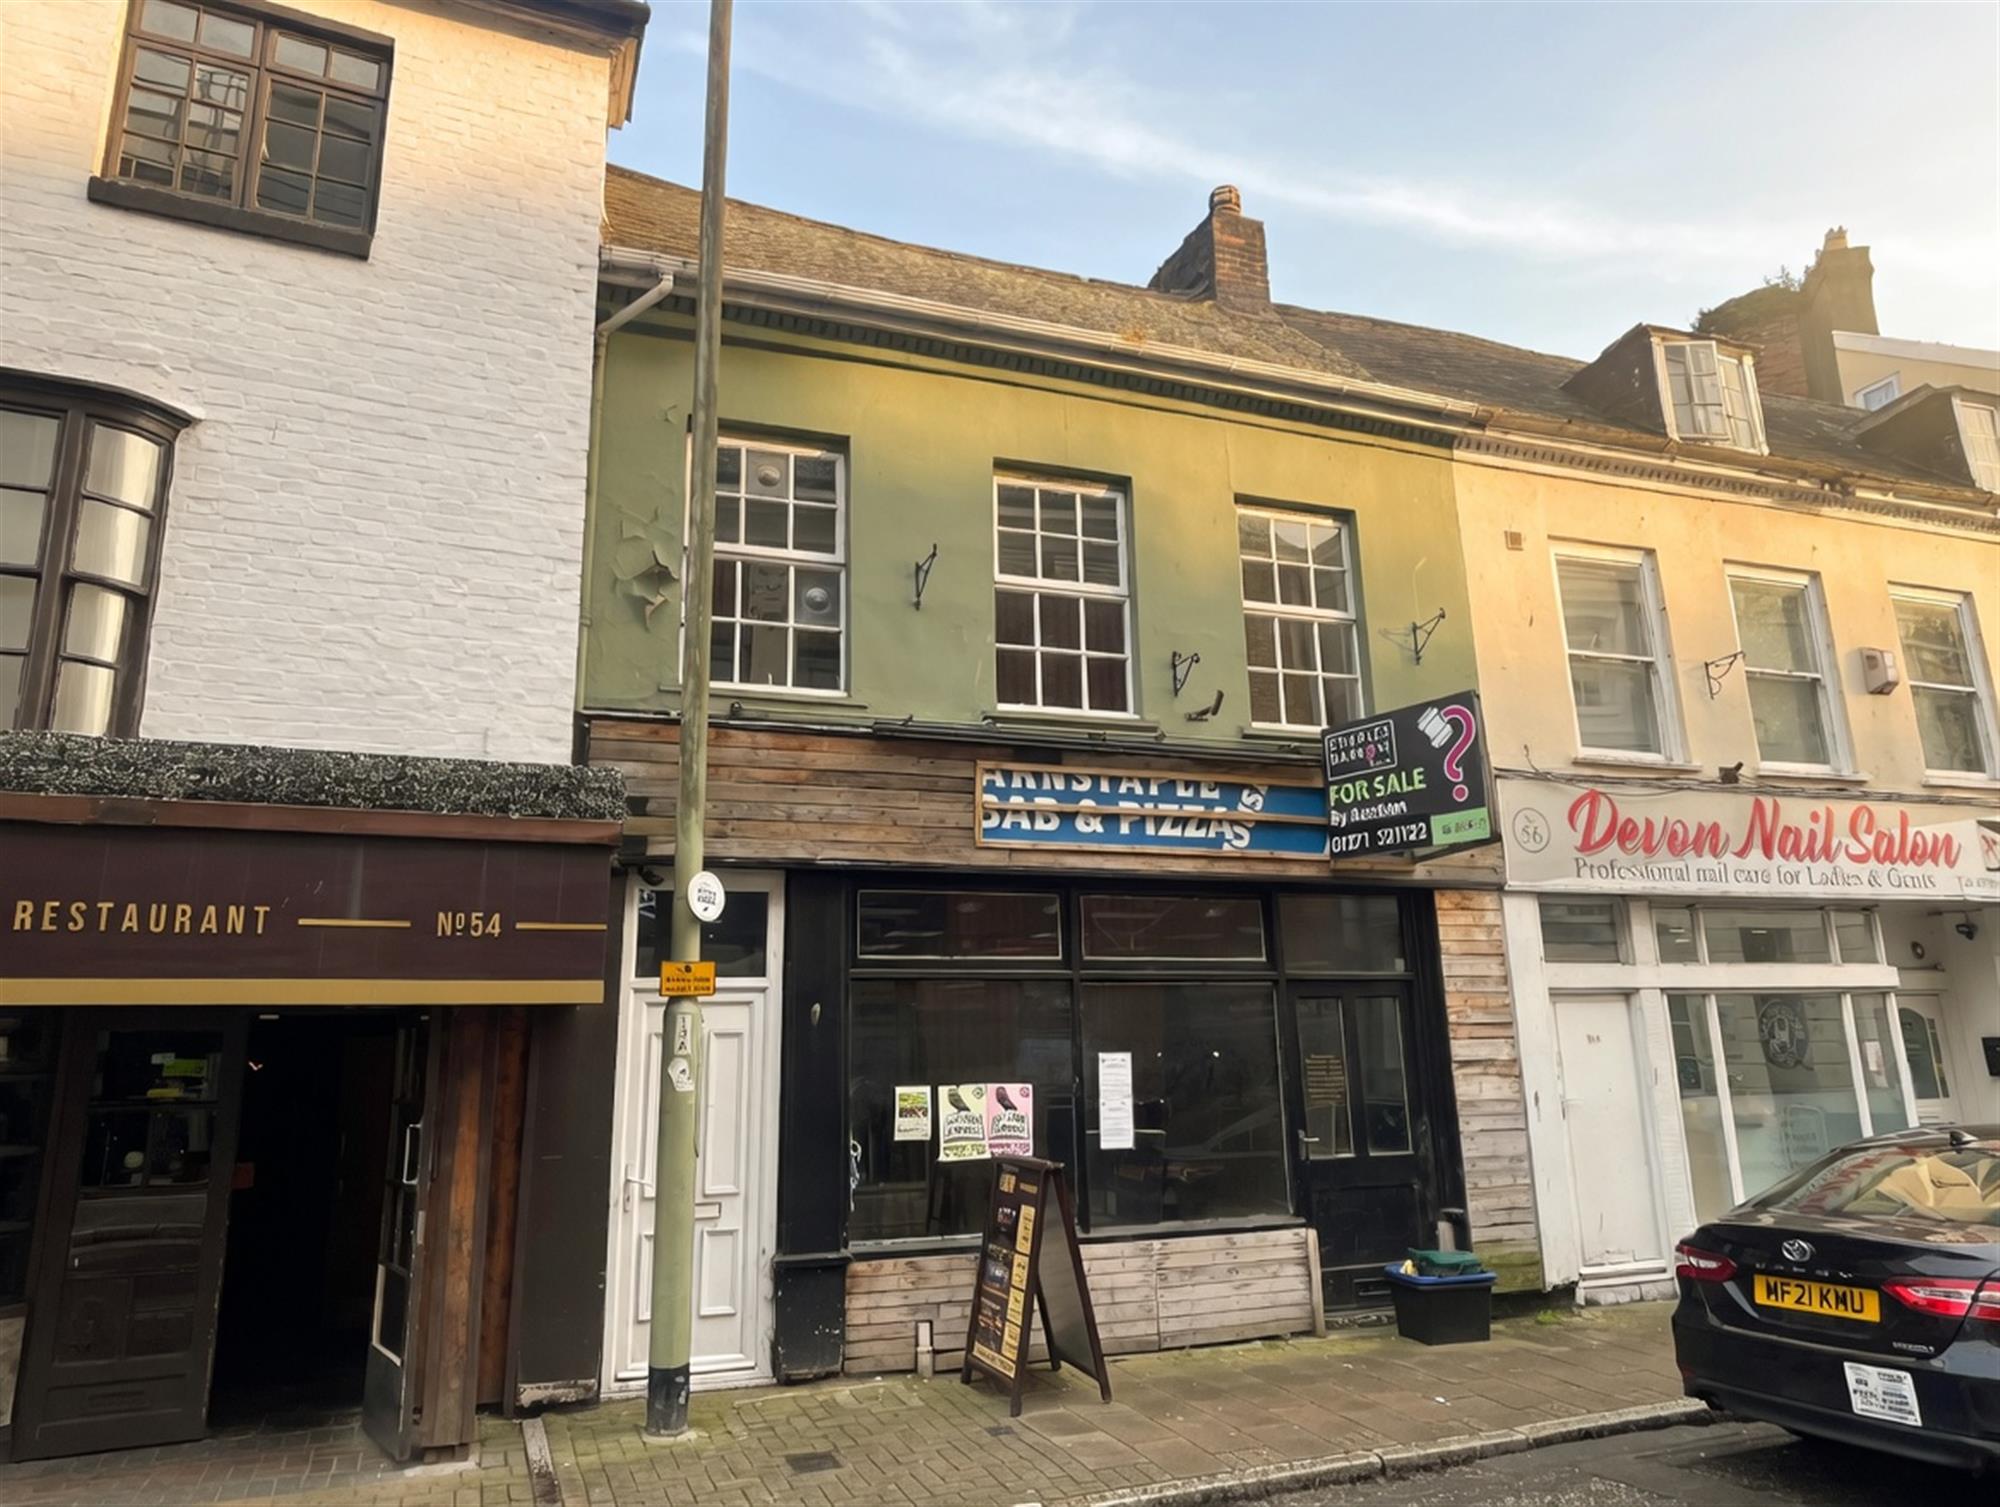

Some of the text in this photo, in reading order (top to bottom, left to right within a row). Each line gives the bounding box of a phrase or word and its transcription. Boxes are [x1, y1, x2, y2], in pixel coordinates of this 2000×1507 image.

[1329, 767, 1427, 806] FOR SALE
[1074, 799, 1104, 833] &
[1567, 788, 1961, 868] Devon Nail Salon
[1520, 825, 1543, 845] 56
[1696, 861, 1728, 883] nail
[1734, 867, 1771, 884] care
[1777, 865, 1800, 885] for
[1868, 869, 1882, 888] &
[12, 900, 271, 935] RESTAURANT
[1766, 1278, 1864, 1314] MF21 KMU
